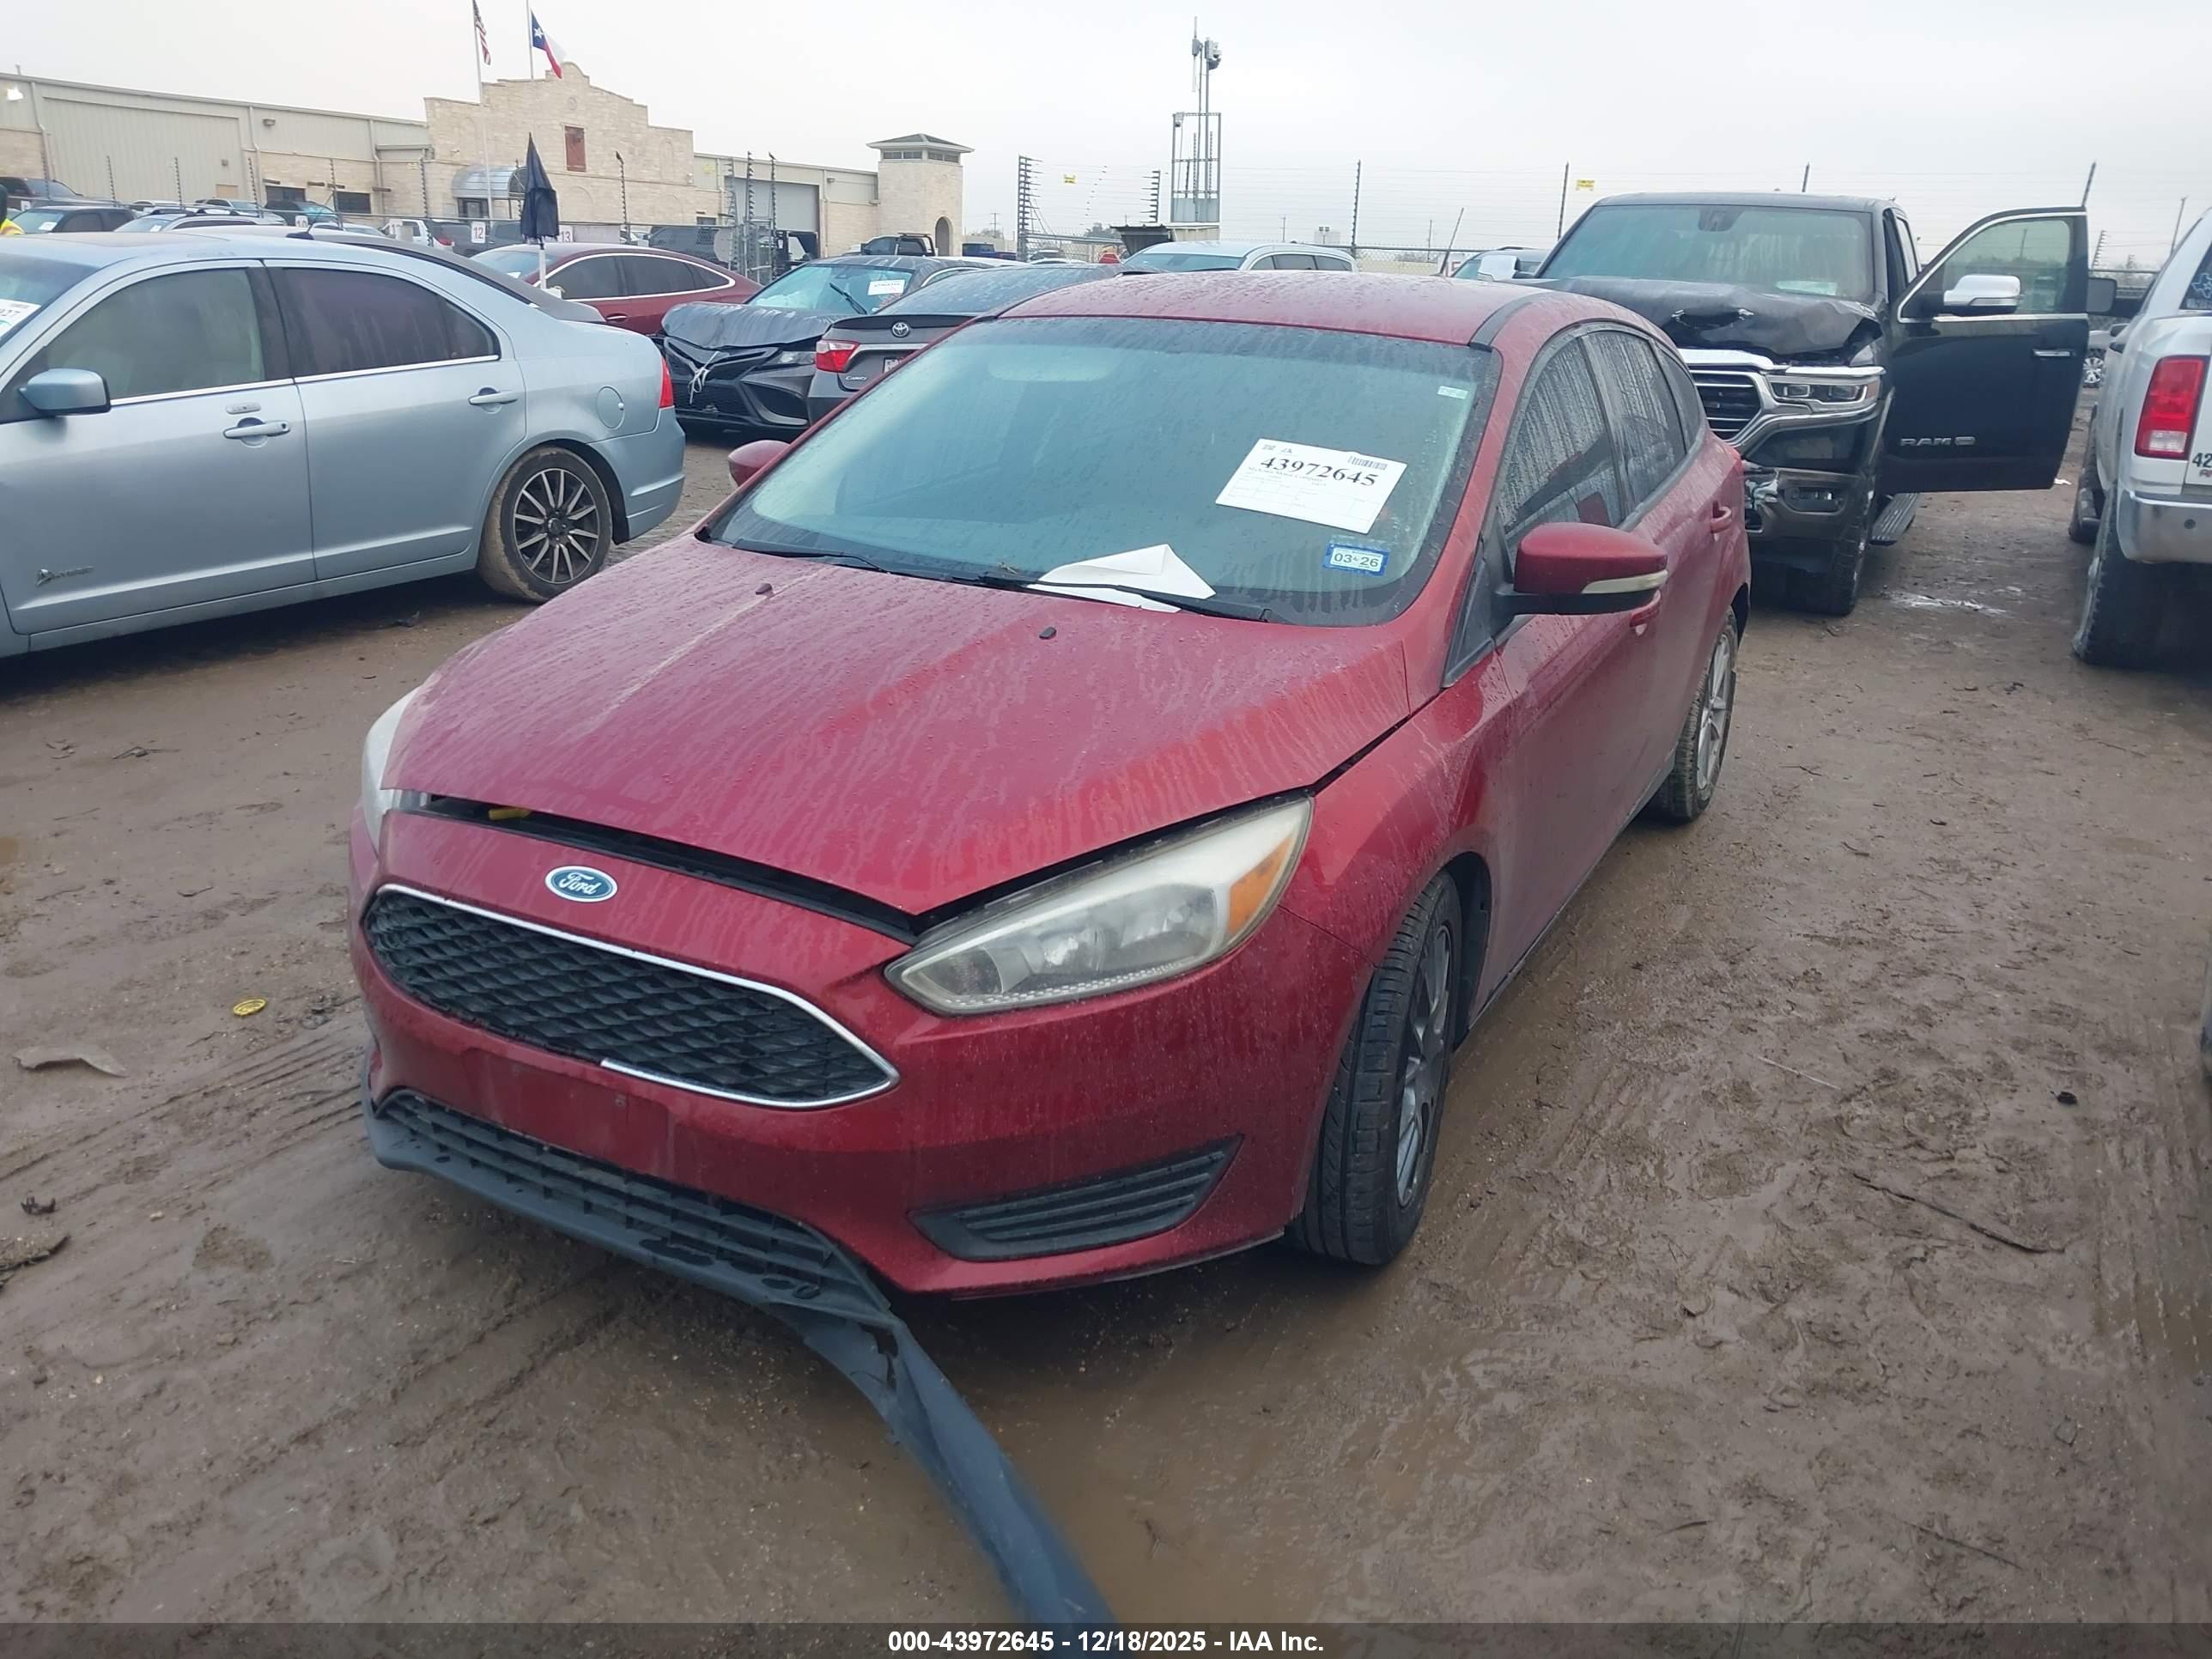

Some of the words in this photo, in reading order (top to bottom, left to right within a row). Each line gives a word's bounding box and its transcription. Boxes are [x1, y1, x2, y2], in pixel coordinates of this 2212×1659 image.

[473, 226, 483, 240] 12
[1900, 437, 1952, 447] RAM
[1261, 457, 1379, 487] 43972645
[1334, 553, 1352, 563] 03
[1359, 556, 1380, 568] 26
[559, 872, 602, 895] Ford
